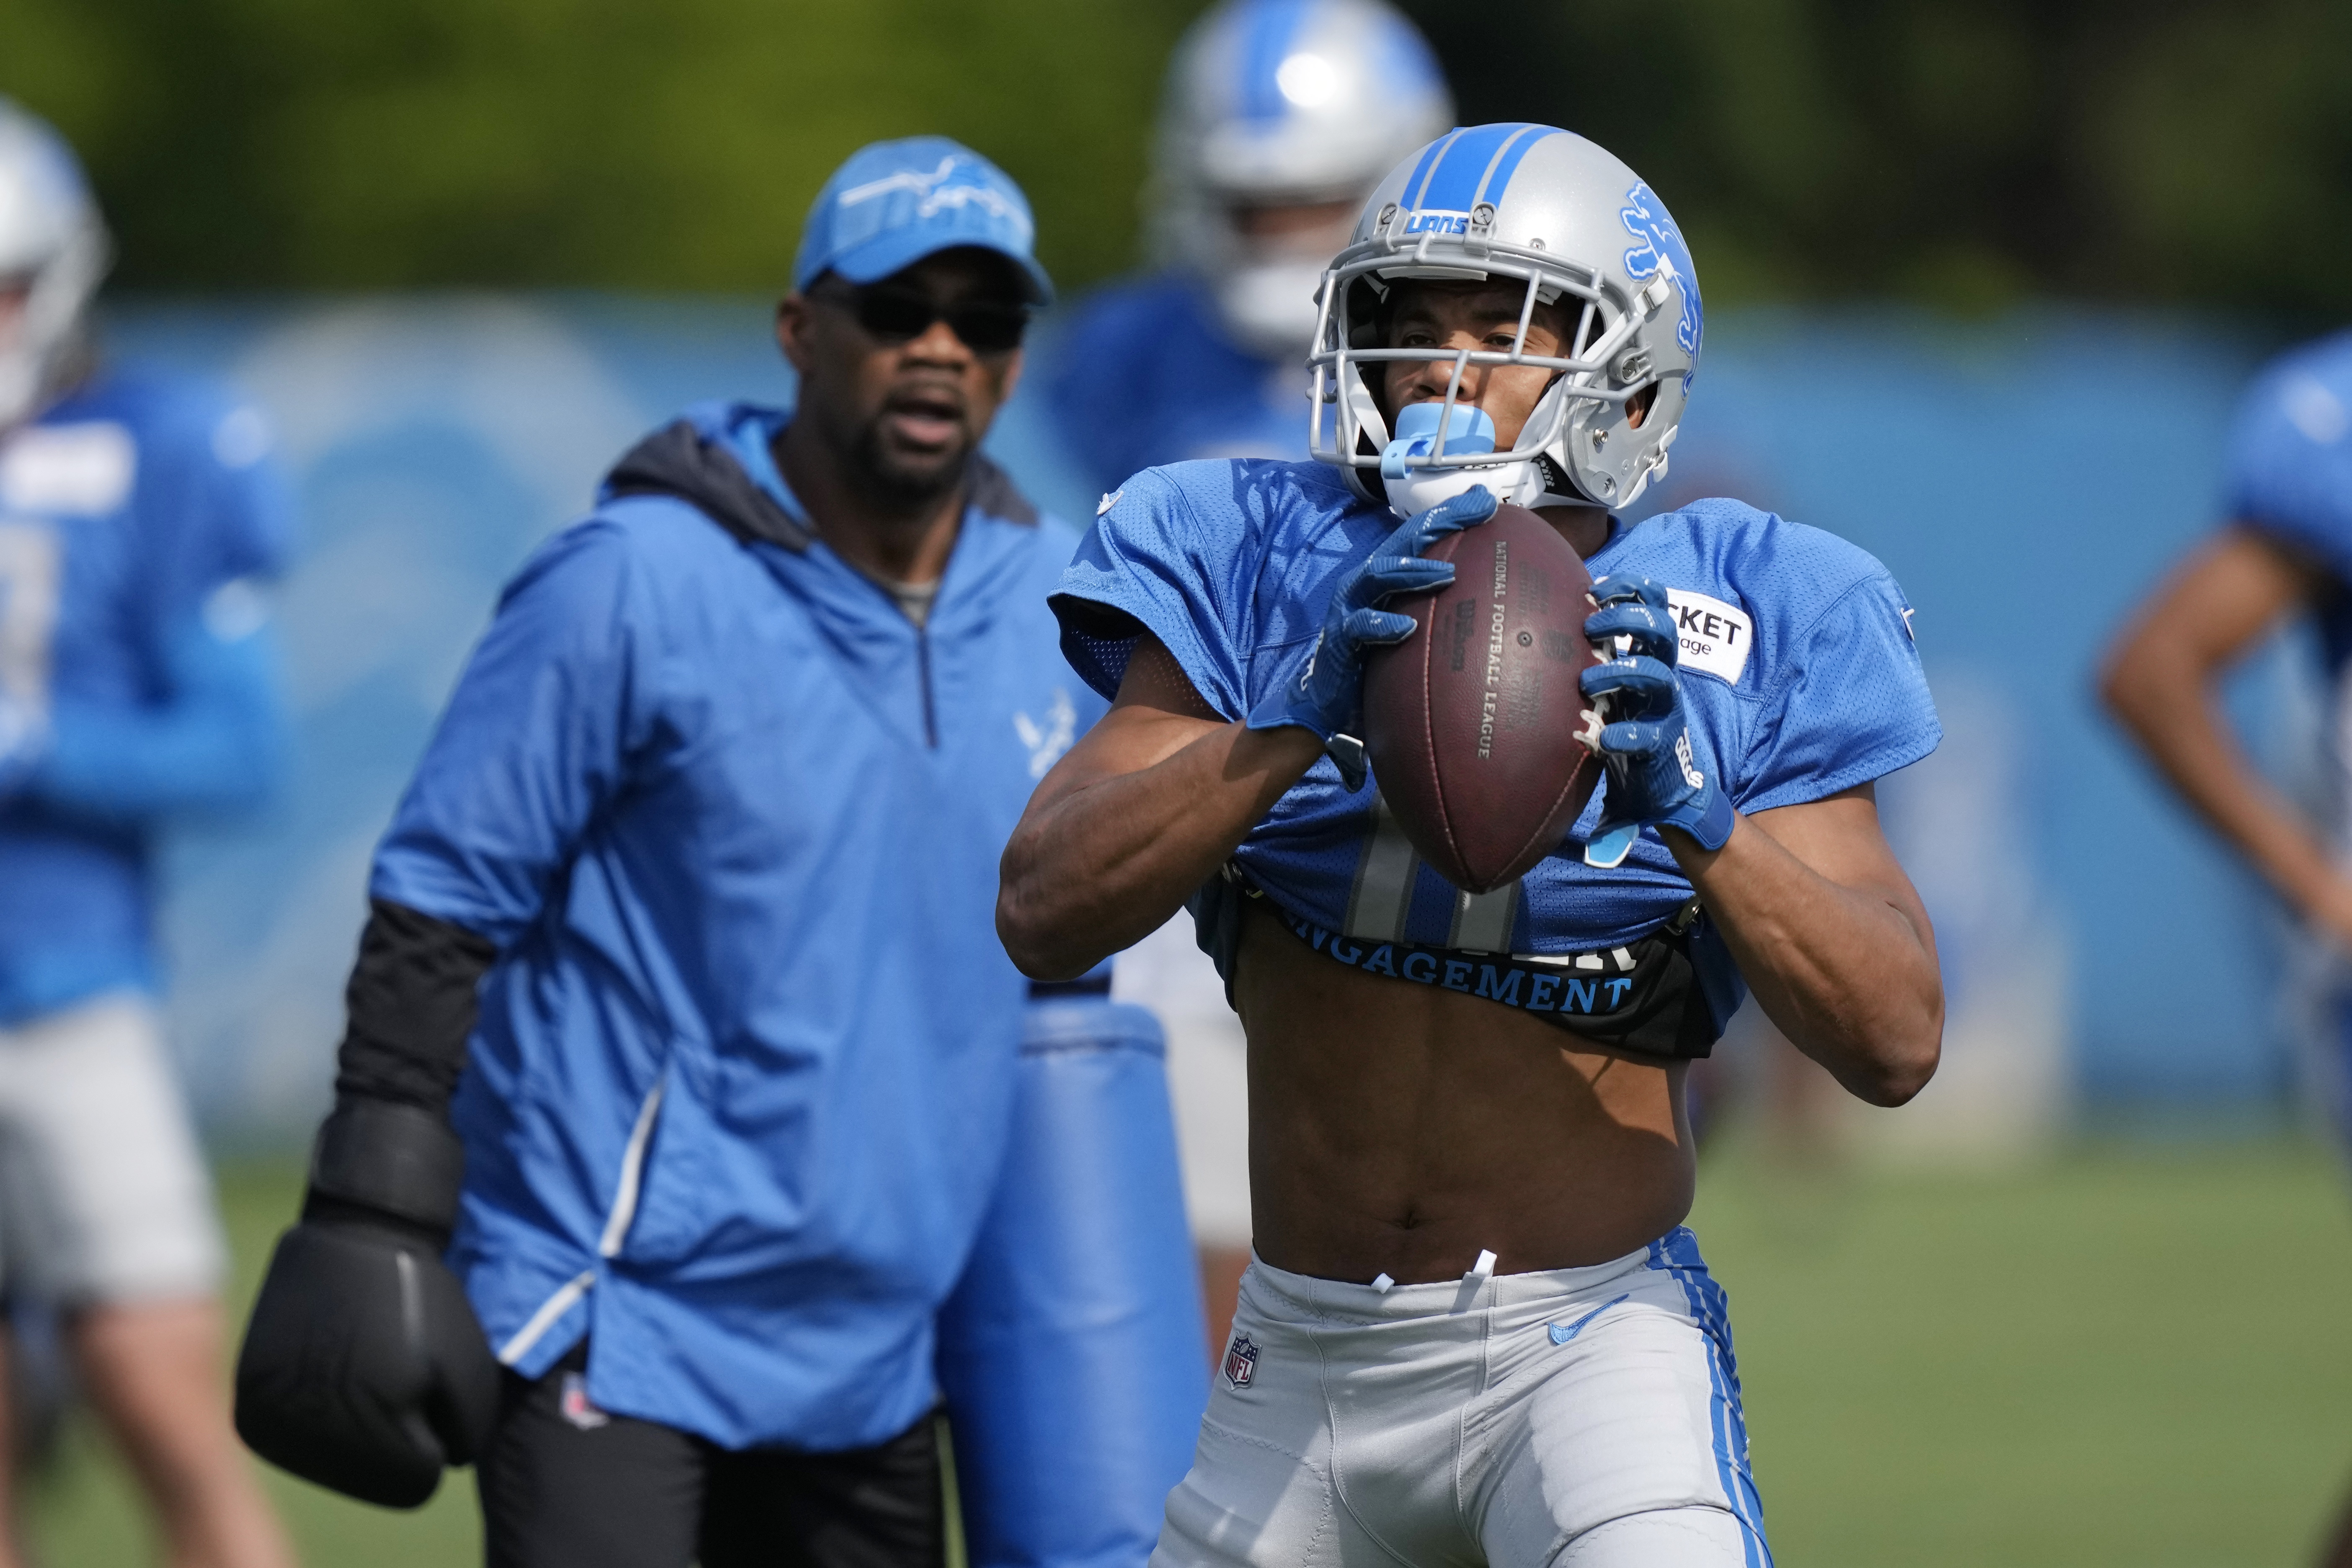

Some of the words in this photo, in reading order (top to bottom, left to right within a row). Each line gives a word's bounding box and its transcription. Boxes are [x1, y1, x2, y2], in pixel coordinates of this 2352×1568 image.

[1494, 541, 1507, 598] NATIONAL
[1487, 603, 1505, 685] FOOTBALL
[1668, 603, 1742, 645] KET
[1478, 691, 1498, 759] LEAGUE
[1283, 910, 1632, 1014] NGAGEMENT
[1227, 1354, 1249, 1380] NFL
